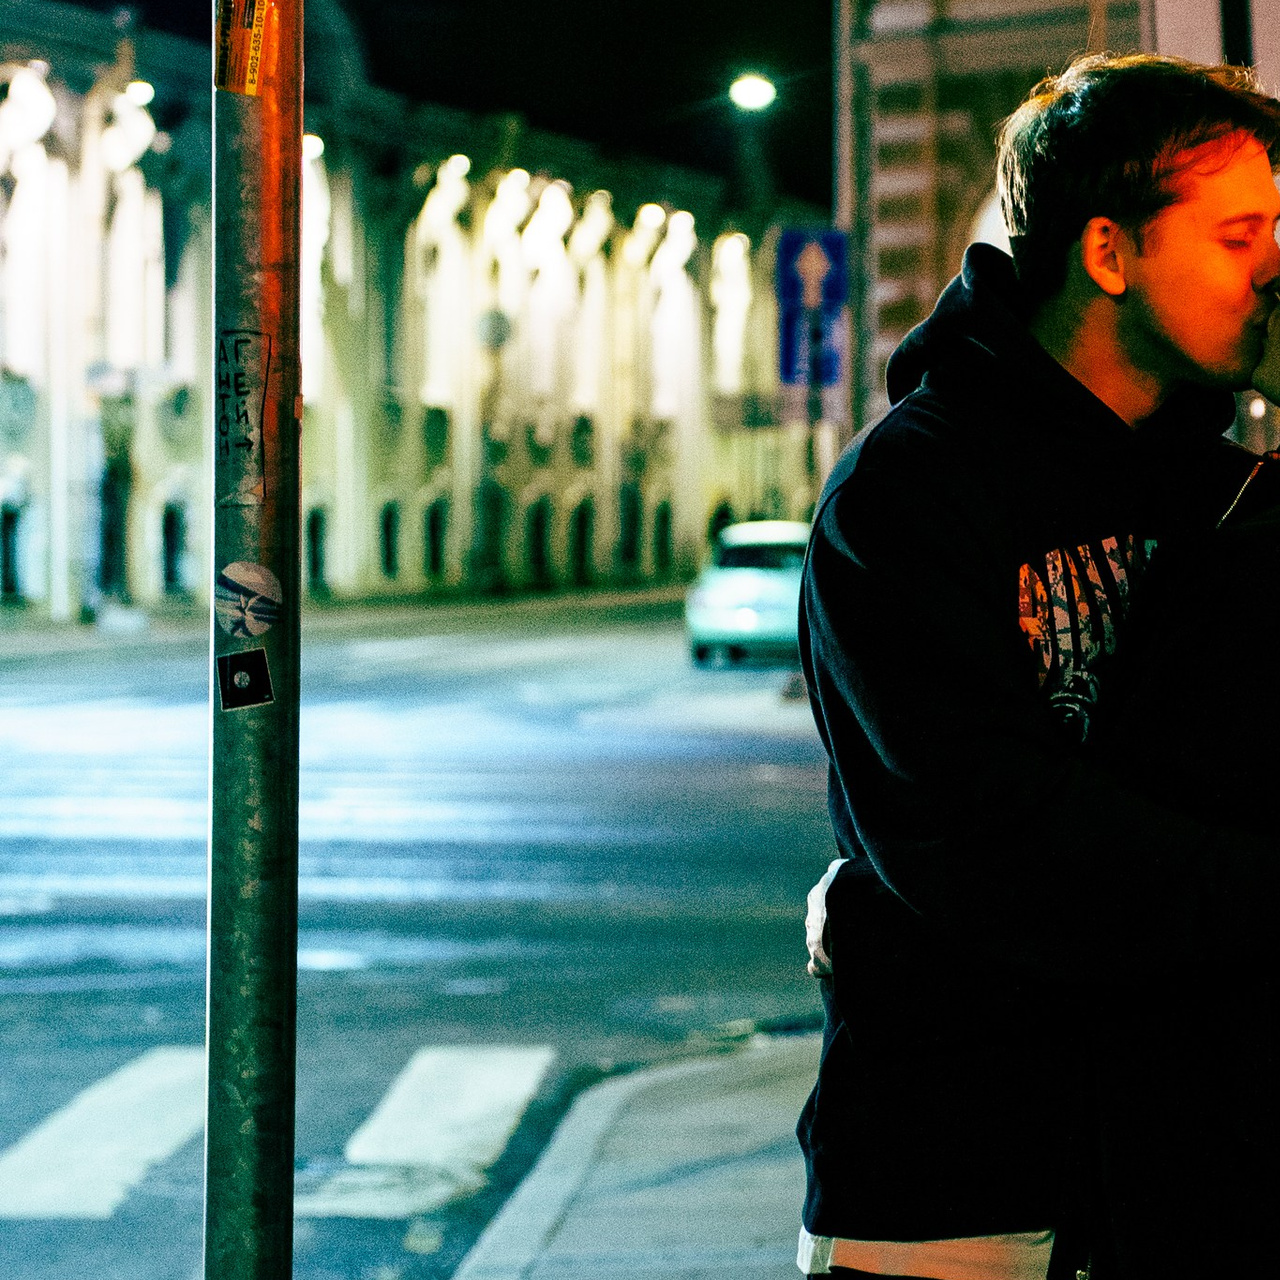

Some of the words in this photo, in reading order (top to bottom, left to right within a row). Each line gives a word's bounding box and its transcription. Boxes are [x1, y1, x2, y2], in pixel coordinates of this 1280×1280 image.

[248, 0, 266, 85] 8-902-635-10-10
[218, 339, 231, 457] АНТОН
[234, 338, 251, 425] ГЕЙ
